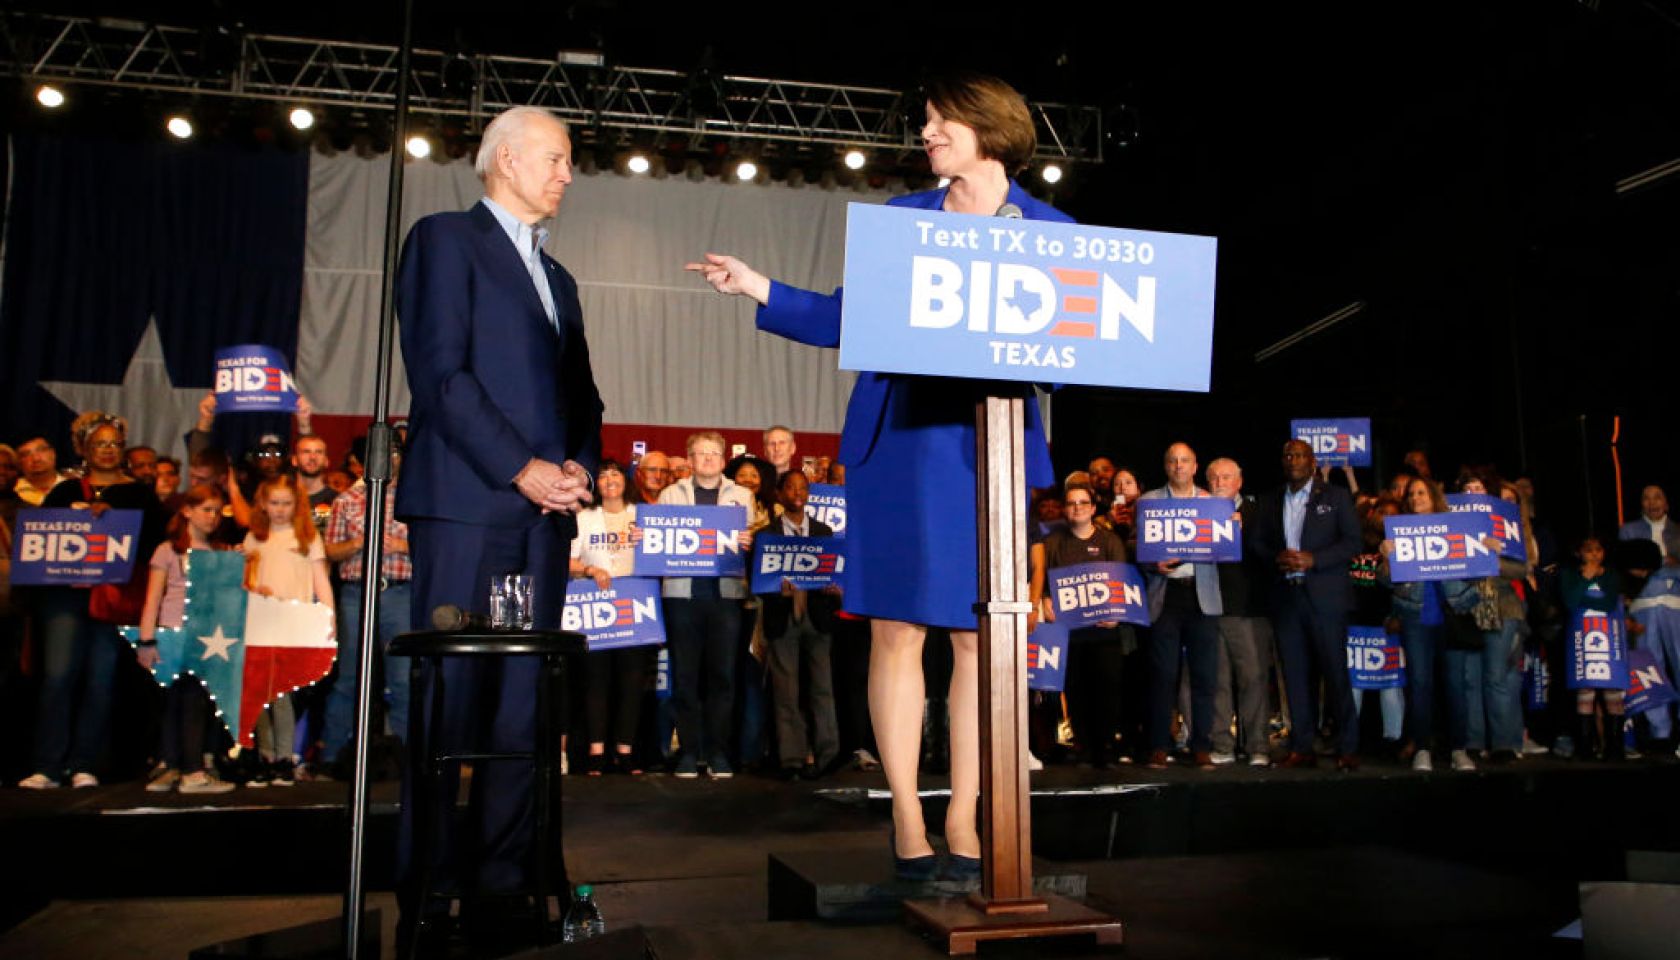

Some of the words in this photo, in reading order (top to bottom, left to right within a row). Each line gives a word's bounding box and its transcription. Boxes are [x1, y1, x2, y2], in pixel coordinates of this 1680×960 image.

[915, 220, 979, 250] Text
[988, 227, 1026, 253] TX
[1036, 238, 1064, 258] to
[1073, 235, 1155, 265] 30330
[909, 255, 1156, 344] BIDEN
[217, 357, 246, 367] TEXAS
[247, 356, 267, 366] FOR
[989, 340, 1076, 369] TEXAS
[215, 366, 298, 393] BIDEN
[808, 494, 831, 505] EXAS
[832, 496, 846, 506] FO
[1473, 503, 1492, 513] FOR
[643, 516, 679, 527] TEXAS
[680, 516, 703, 527] FOR
[1144, 508, 1176, 518] TEXAS
[1177, 508, 1198, 517] FOR
[23, 521, 64, 532] TEXAS
[65, 521, 92, 532] FOR
[1144, 518, 1234, 543] BIDEN
[1393, 526, 1426, 535] TEXAS
[1427, 524, 1448, 534] FOR
[20, 533, 132, 562] BIDEN
[642, 527, 740, 555] BIDEN
[763, 544, 799, 553] TEXAS
[800, 545, 823, 554] FOR
[1394, 532, 1489, 562] BIDEN
[1056, 573, 1088, 587] TEXAS
[1089, 572, 1109, 581] FOR
[565, 592, 593, 603] EXAS
[595, 590, 617, 600] FOR
[1057, 580, 1142, 612] BIDEN
[561, 596, 657, 631] BIDEN
[1366, 637, 1387, 646] FOR
[1574, 631, 1584, 650] FOR
[1574, 650, 1584, 681] TEXAS
